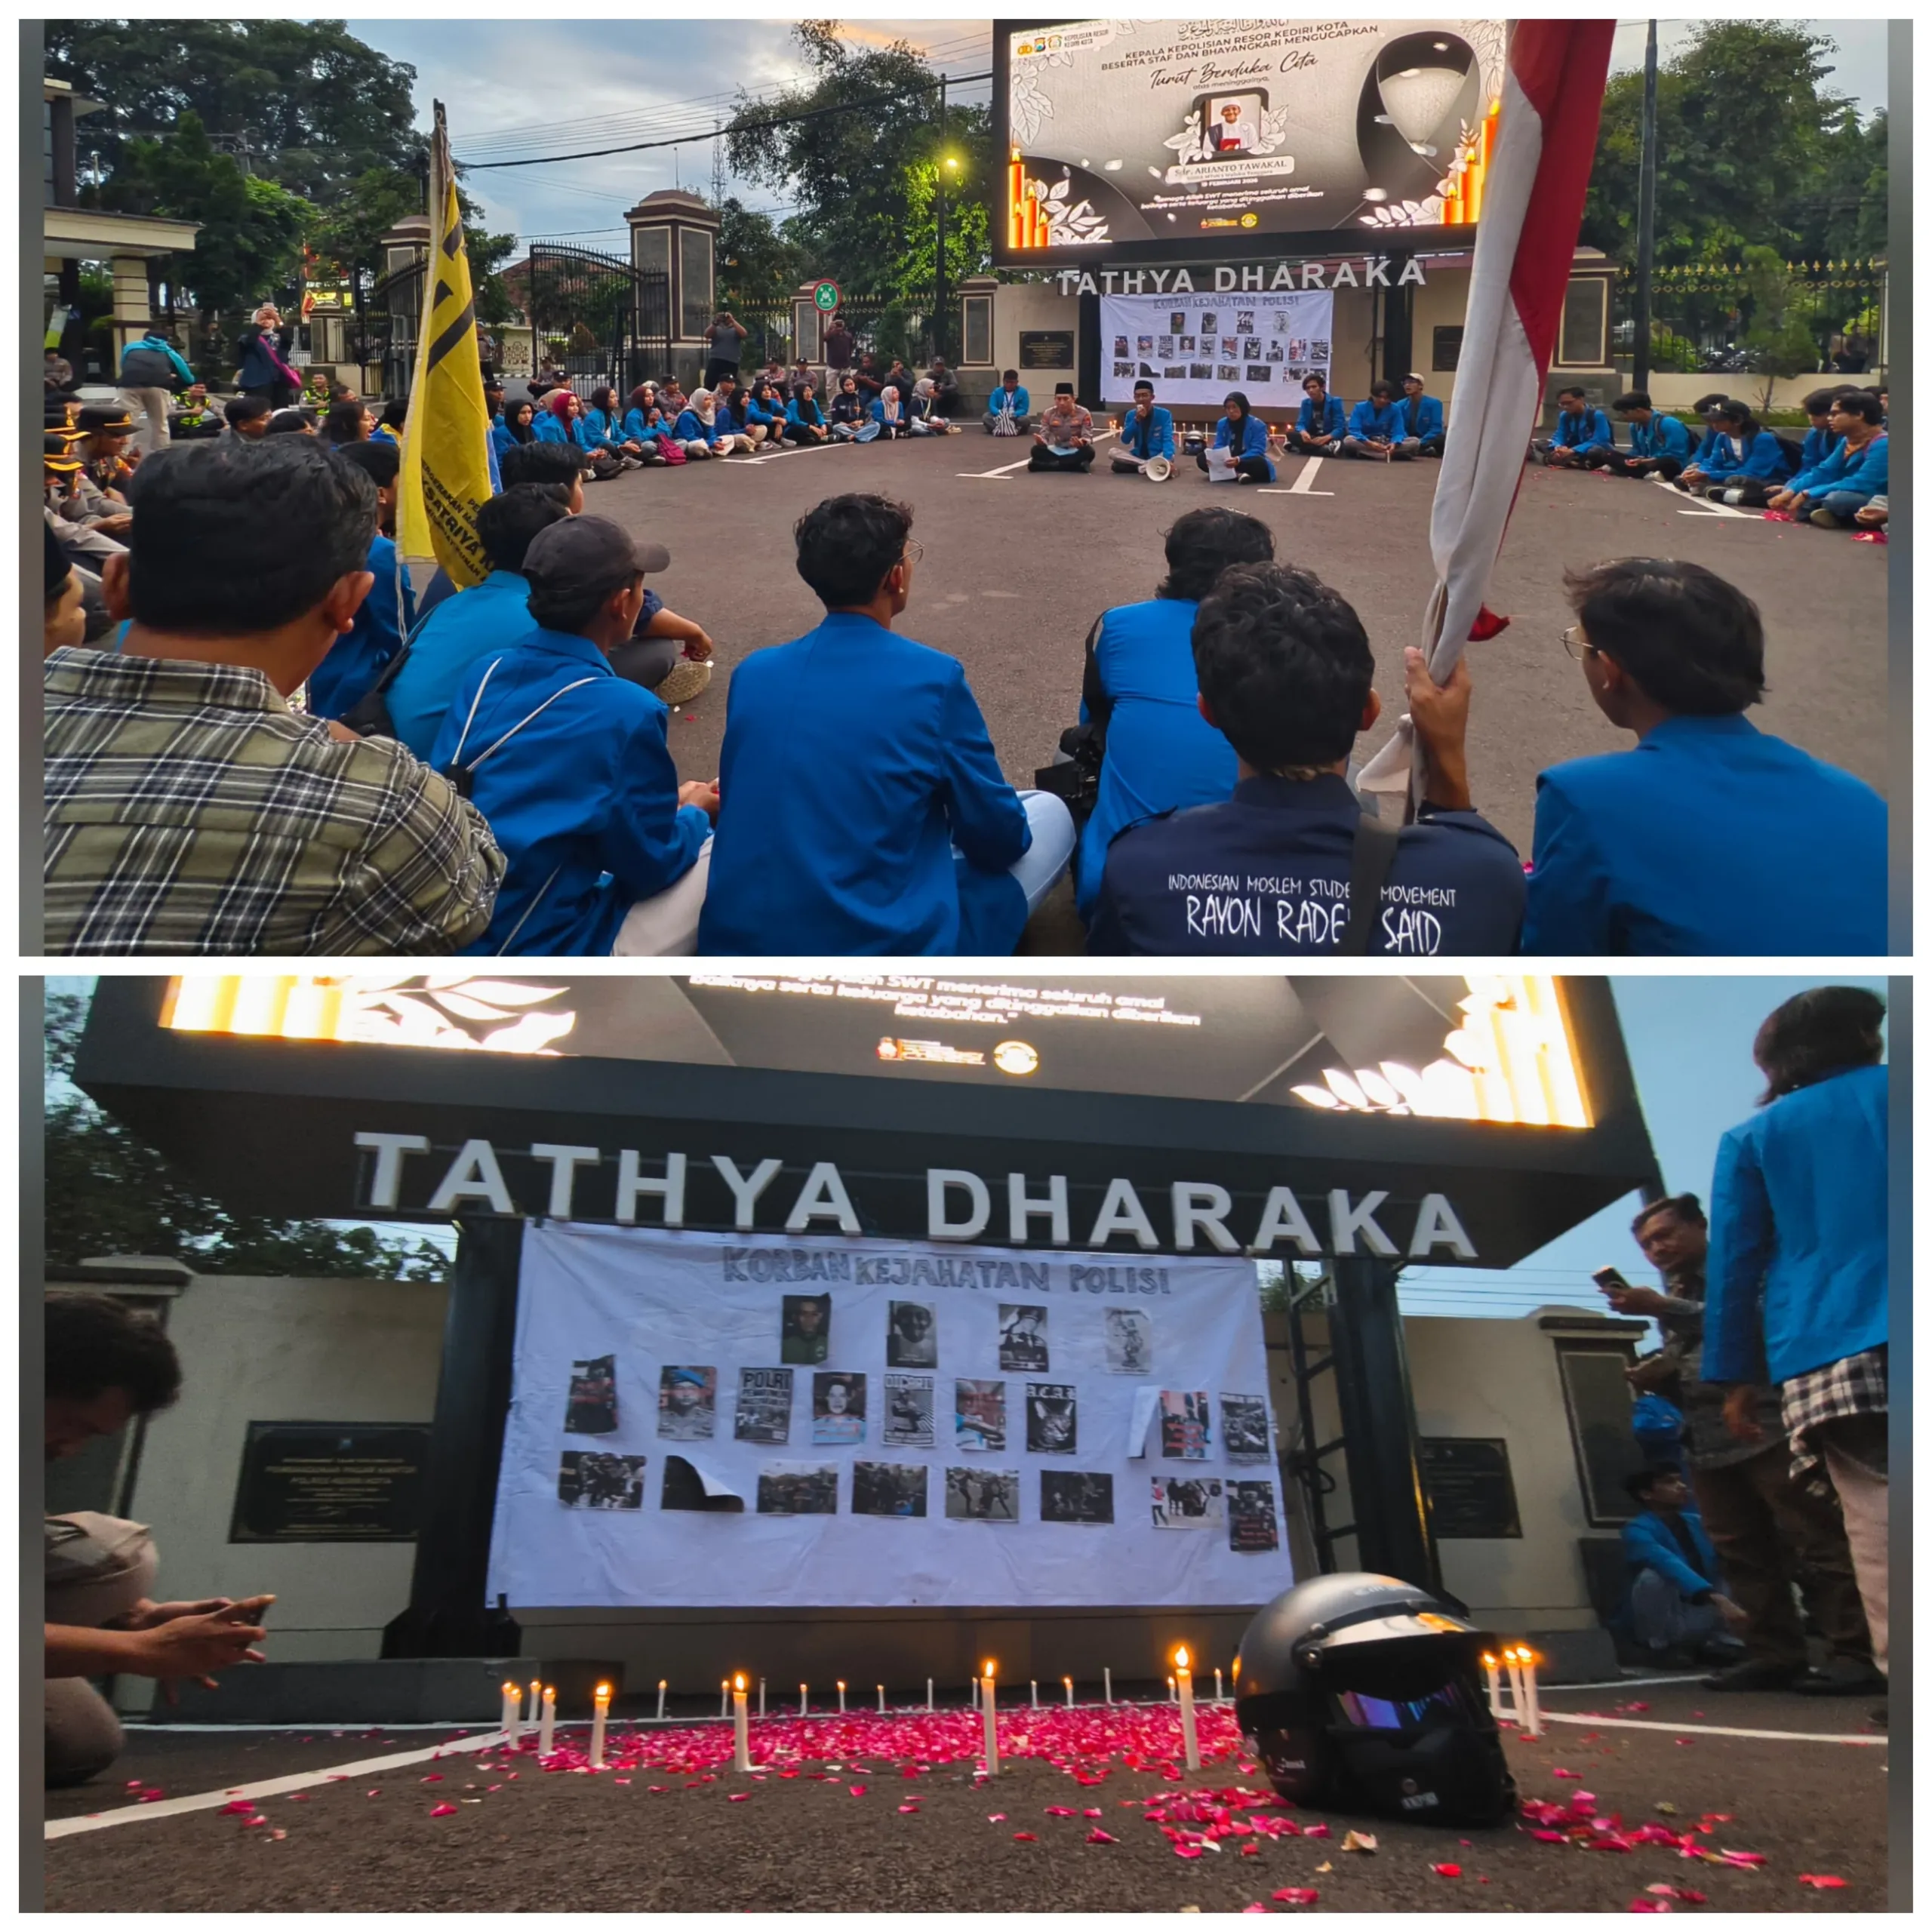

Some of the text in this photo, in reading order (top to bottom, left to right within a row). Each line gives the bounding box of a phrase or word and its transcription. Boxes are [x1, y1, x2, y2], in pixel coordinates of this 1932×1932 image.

[1101, 25, 1379, 70] BESERTA STAF DAN BHAYANGKARI MENGUCAPKAN
[1125, 20, 1349, 60] KEPALA KEPOLISIAN RESOR KEDIRI KOTA
[1151, 50, 1319, 89] Turut Berduka Cita
[1193, 81, 1209, 90] atas
[1195, 164, 1237, 176] ARIANTO
[1238, 160, 1287, 171] TAWAKAL
[1057, 258, 1426, 297] TATHYA DHARAKA
[1262, 295, 1299, 306] POLISI
[421, 457, 465, 515] ERGERAKAN
[1168, 873, 1457, 907] INDONESIAN MOSLEM STUDE MOVEMENT
[1186, 894, 1261, 937] RAYON
[1277, 900, 1351, 943] RADE
[777, 980, 834, 996] serta
[929, 994, 982, 1011] yang
[1111, 1007, 1201, 1026] diberikan
[886, 976, 934, 990] SWT
[935, 980, 1038, 999] menerima
[1040, 989, 1112, 1005] seluruh
[1115, 996, 1165, 1010] amal
[352, 1131, 1478, 1260] TATHYA DHARAKA
[722, 1245, 1171, 1295] KORBAN KEJAHATAN POLISI
[743, 1371, 790, 1389] POLRI
